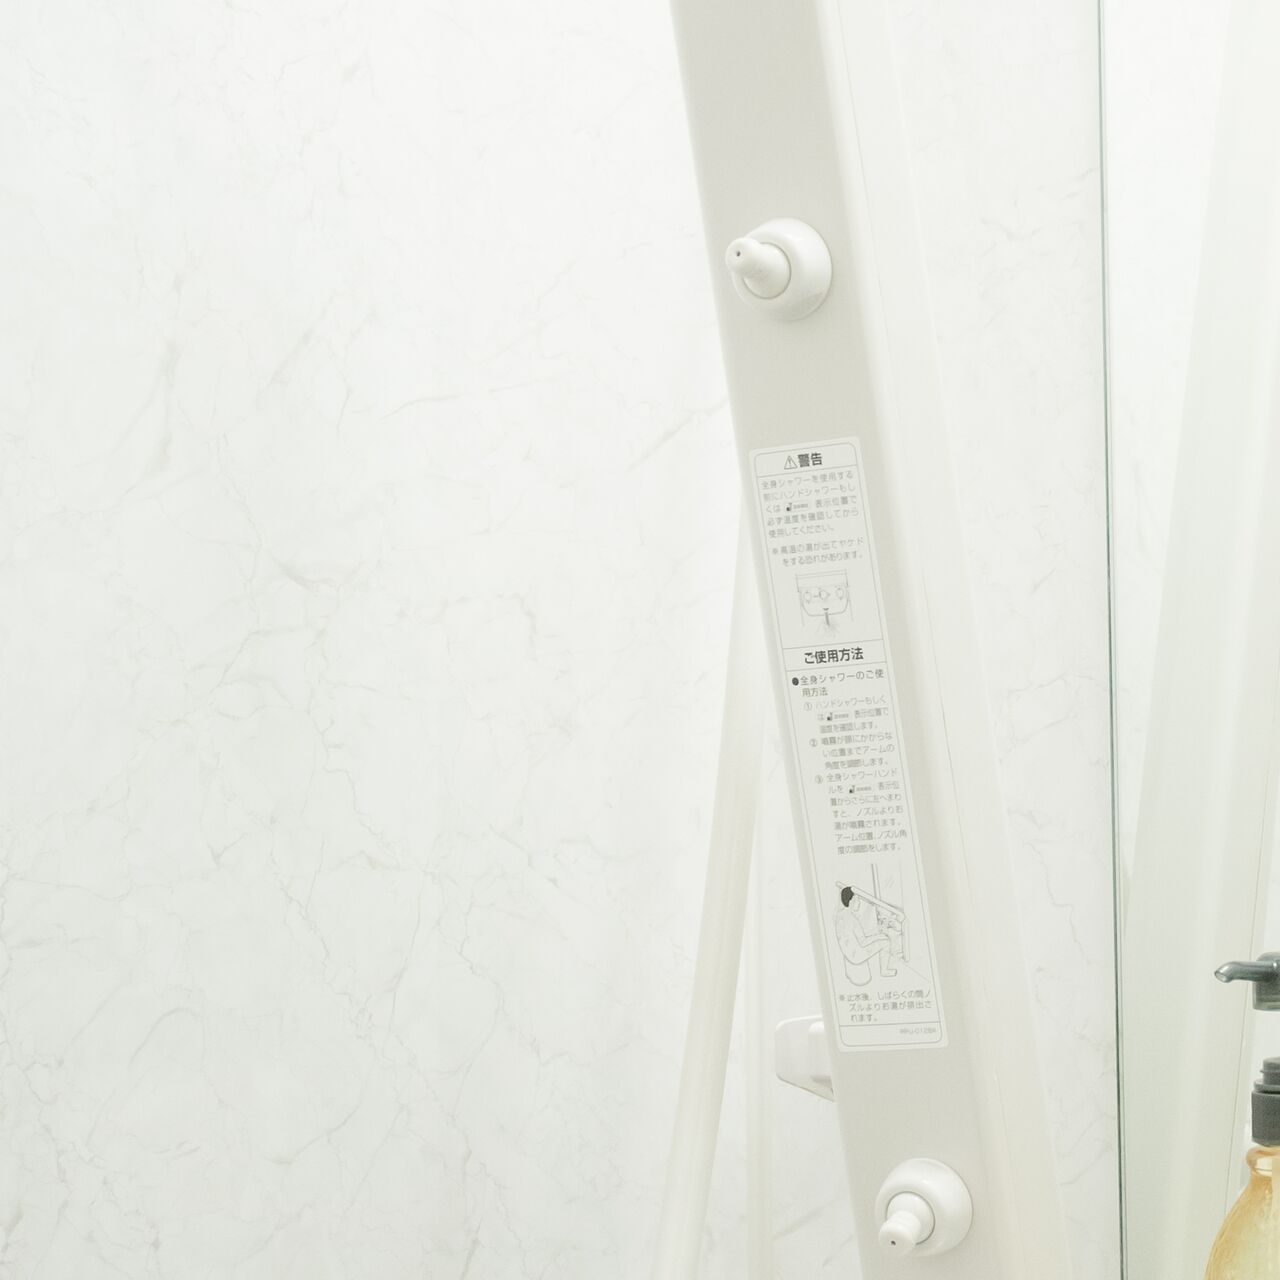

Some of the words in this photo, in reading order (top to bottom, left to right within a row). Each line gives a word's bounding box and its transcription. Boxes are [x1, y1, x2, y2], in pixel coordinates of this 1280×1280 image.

[797, 452, 823, 468] 警告
[804, 647, 864, 664] ご使用方法
[801, 686, 829, 698] 用方法
